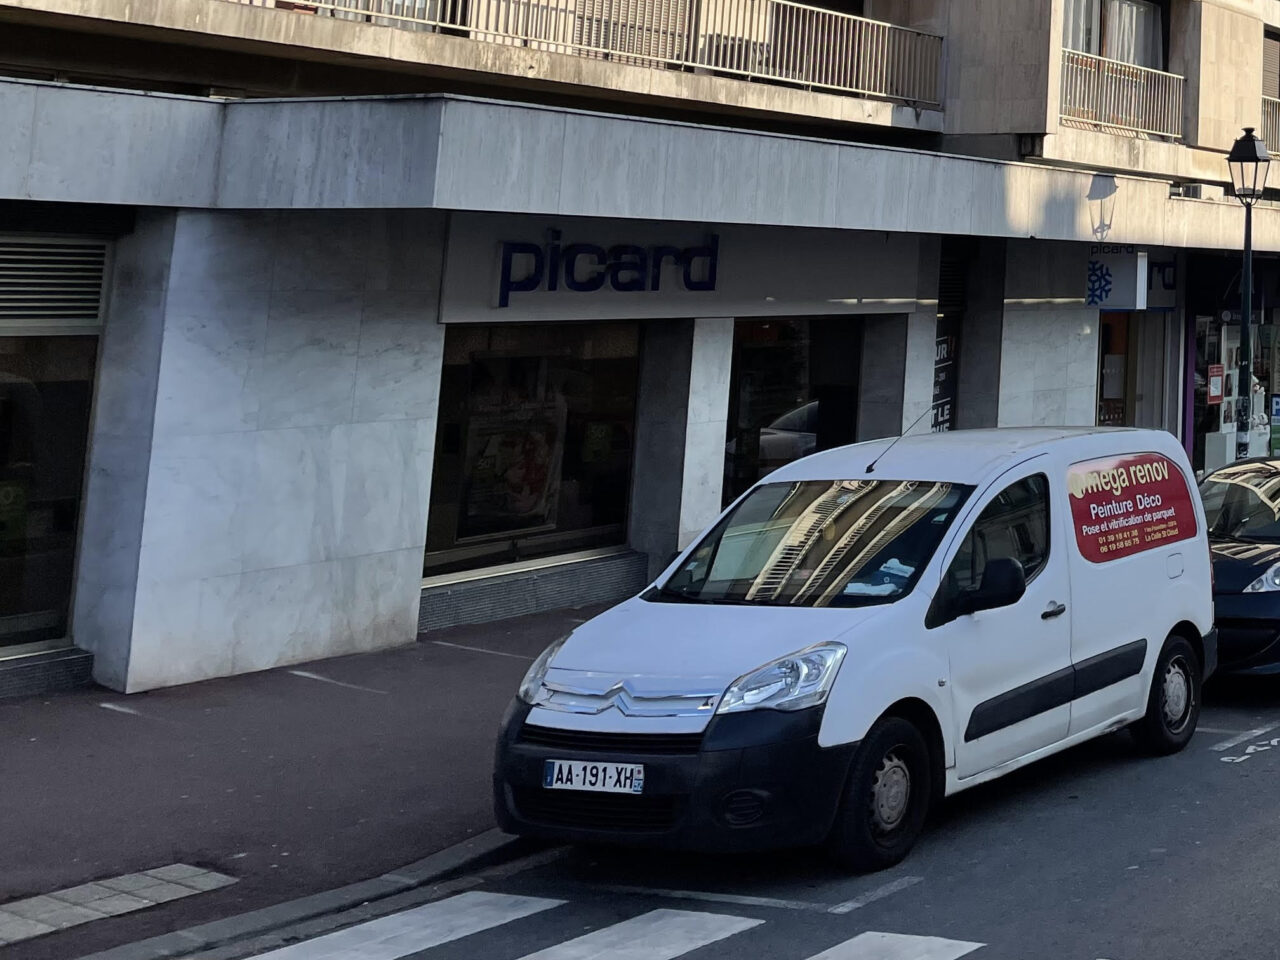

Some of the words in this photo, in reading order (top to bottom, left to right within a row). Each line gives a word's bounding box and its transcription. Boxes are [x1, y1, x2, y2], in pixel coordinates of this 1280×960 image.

[498, 227, 719, 307] picard
[1129, 461, 1169, 486] renov
[1090, 500, 1133, 520] Peinture
[1136, 493, 1162, 510] Déco
[1082, 525, 1100, 536] Pose
[1101, 522, 1108, 532] et
[1108, 515, 1143, 529] vitrification
[1143, 512, 1151, 522] de
[1152, 507, 1176, 523] parquet
[1098, 536, 1106, 544] 01
